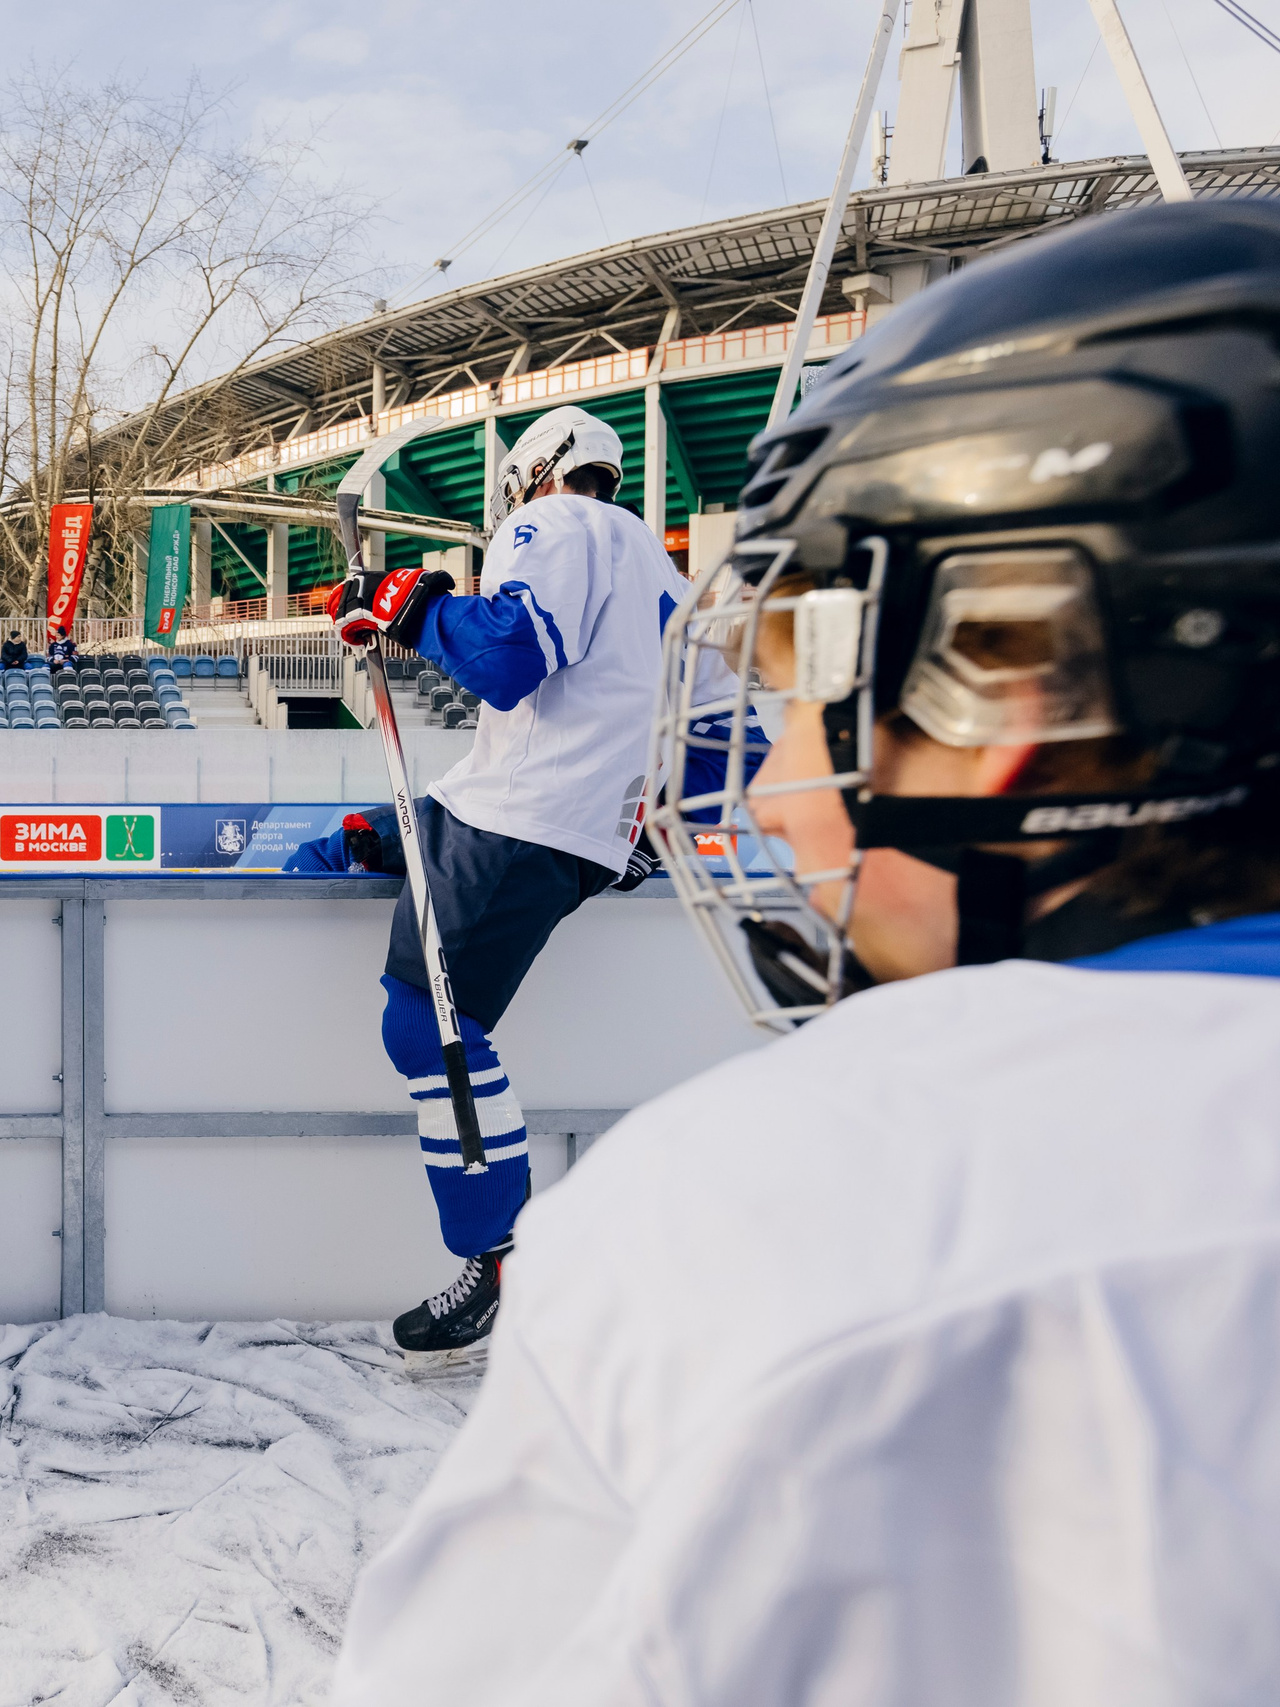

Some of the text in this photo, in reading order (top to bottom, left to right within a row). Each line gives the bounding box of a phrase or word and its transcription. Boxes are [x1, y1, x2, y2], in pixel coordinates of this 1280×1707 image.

[163, 555, 172, 606] ГЕНЕРАЛЬНЫЙ
[170, 572, 179, 606] СПОНСОР
[397, 786, 412, 840] VAPOR
[15, 823, 87, 840] ЗИМА
[251, 821, 312, 831] Департамент
[251, 833, 283, 842] спорта
[15, 842, 87, 852] В МОСКВЕ
[251, 844, 283, 853] города
[435, 984, 448, 1022] BAUER
[476, 1300, 499, 1329] BAUER
